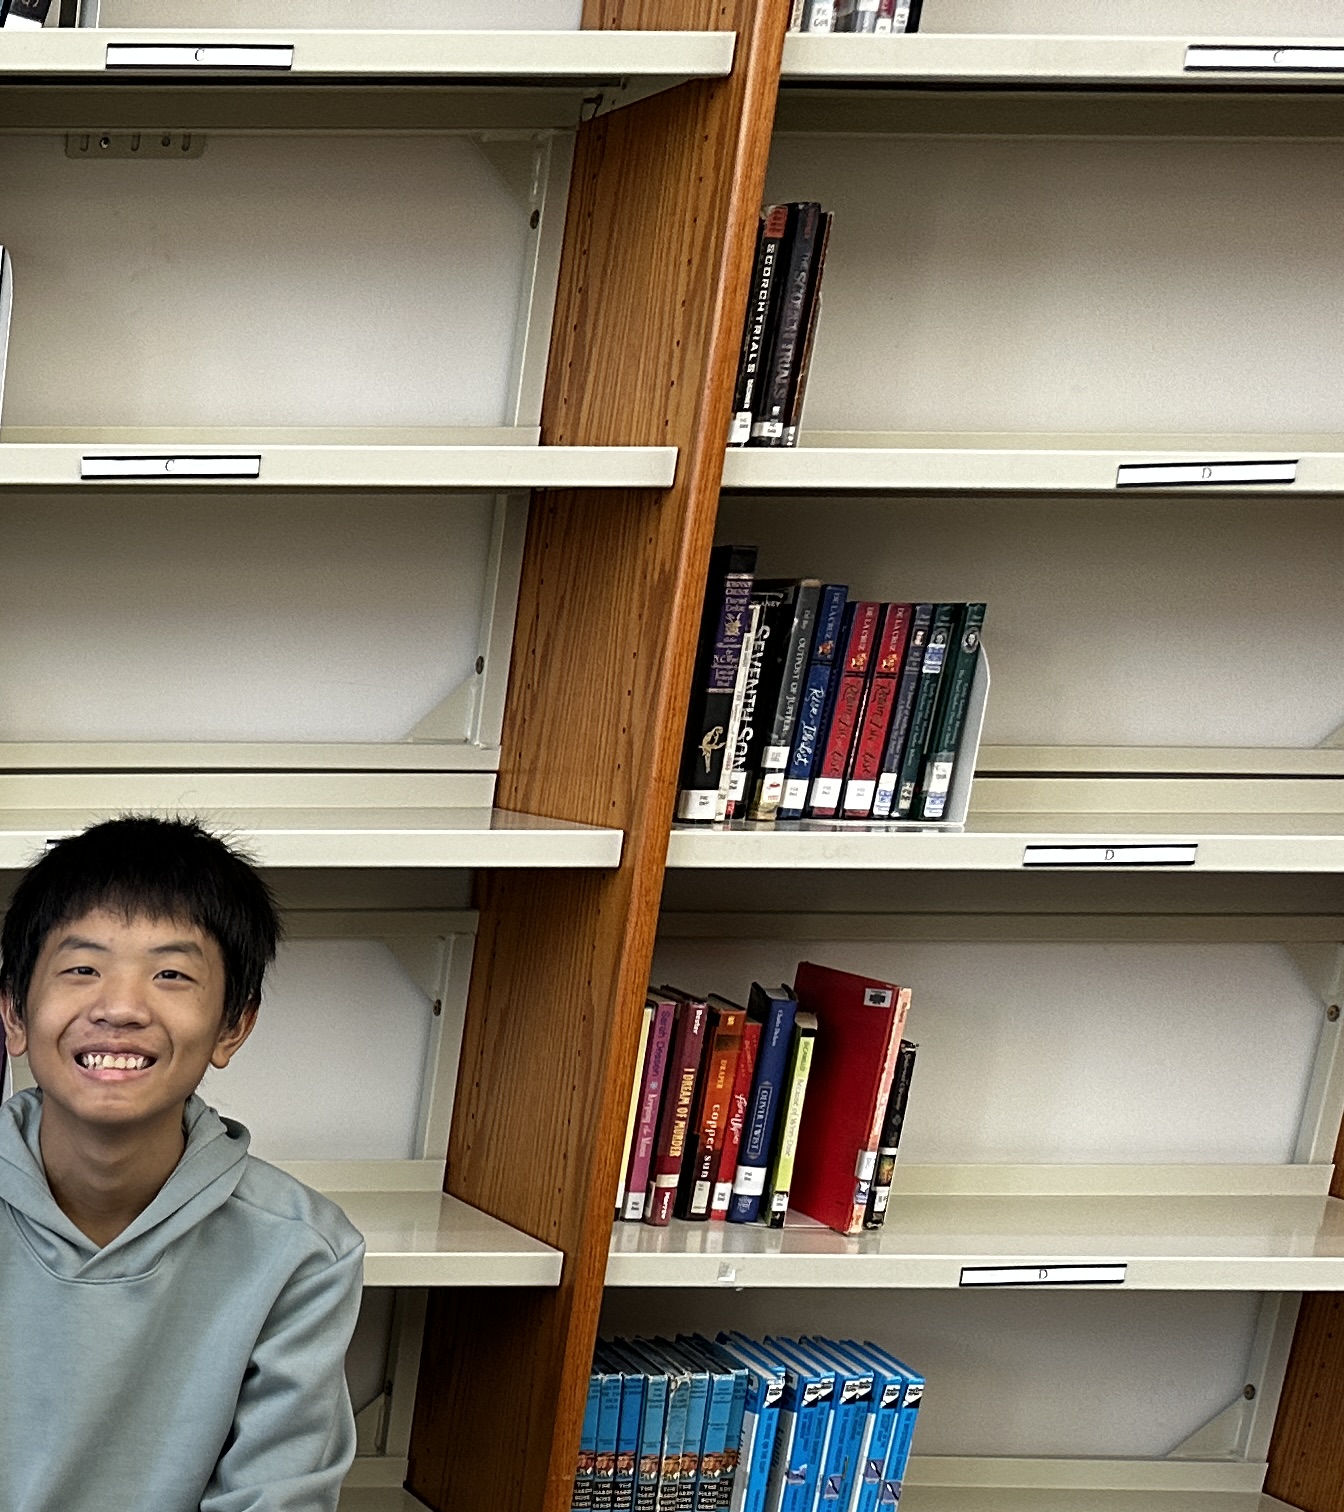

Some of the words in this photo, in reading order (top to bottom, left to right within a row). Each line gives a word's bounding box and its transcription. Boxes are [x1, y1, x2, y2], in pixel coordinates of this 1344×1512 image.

[194, 48, 204, 62] C
[1272, 50, 1285, 63] C
[757, 244, 775, 312] SCORCH
[746, 315, 763, 373] TRIALS
[165, 459, 175, 472] C
[1201, 467, 1212, 479] D
[739, 625, 771, 721] SEVENTH
[1104, 849, 1115, 861] D
[679, 1074, 694, 1105] DREAM
[676, 1107, 689, 1118] OF
[756, 1090, 769, 1120] OLIVER
[669, 1120, 686, 1157] MURDER
[704, 1104, 722, 1151] copper
[751, 1123, 764, 1150] TWIST
[700, 1155, 712, 1178] sun
[1038, 1268, 1048, 1280] D
